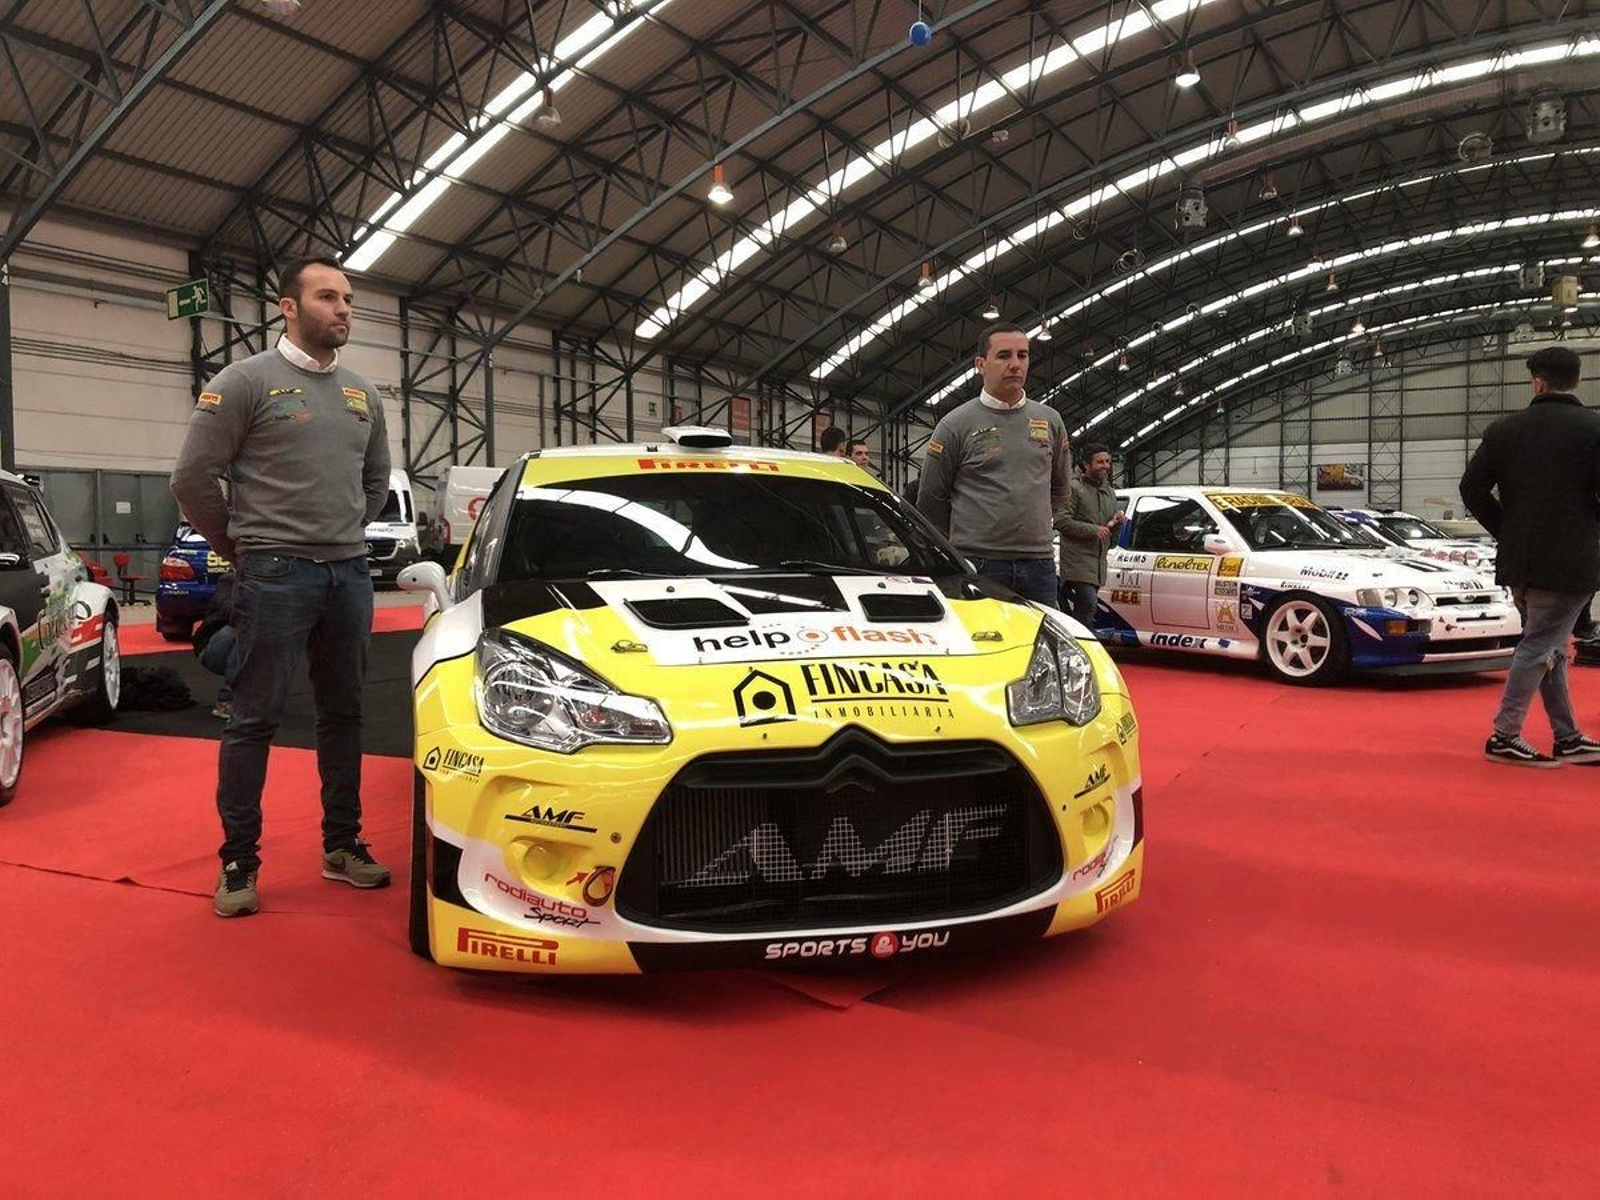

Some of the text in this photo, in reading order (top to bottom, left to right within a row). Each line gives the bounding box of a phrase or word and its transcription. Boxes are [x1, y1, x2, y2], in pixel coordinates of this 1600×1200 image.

[692, 625, 939, 653] help flash
[800, 661, 949, 696] FINCASA
[813, 704, 955, 720] INMOBILIARIA
[520, 805, 586, 824] AMF
[677, 803, 1008, 888] AMF
[484, 872, 588, 919] rodiauto
[456, 926, 560, 966] PIRELLI
[764, 931, 950, 960] SPORTS & YOU
